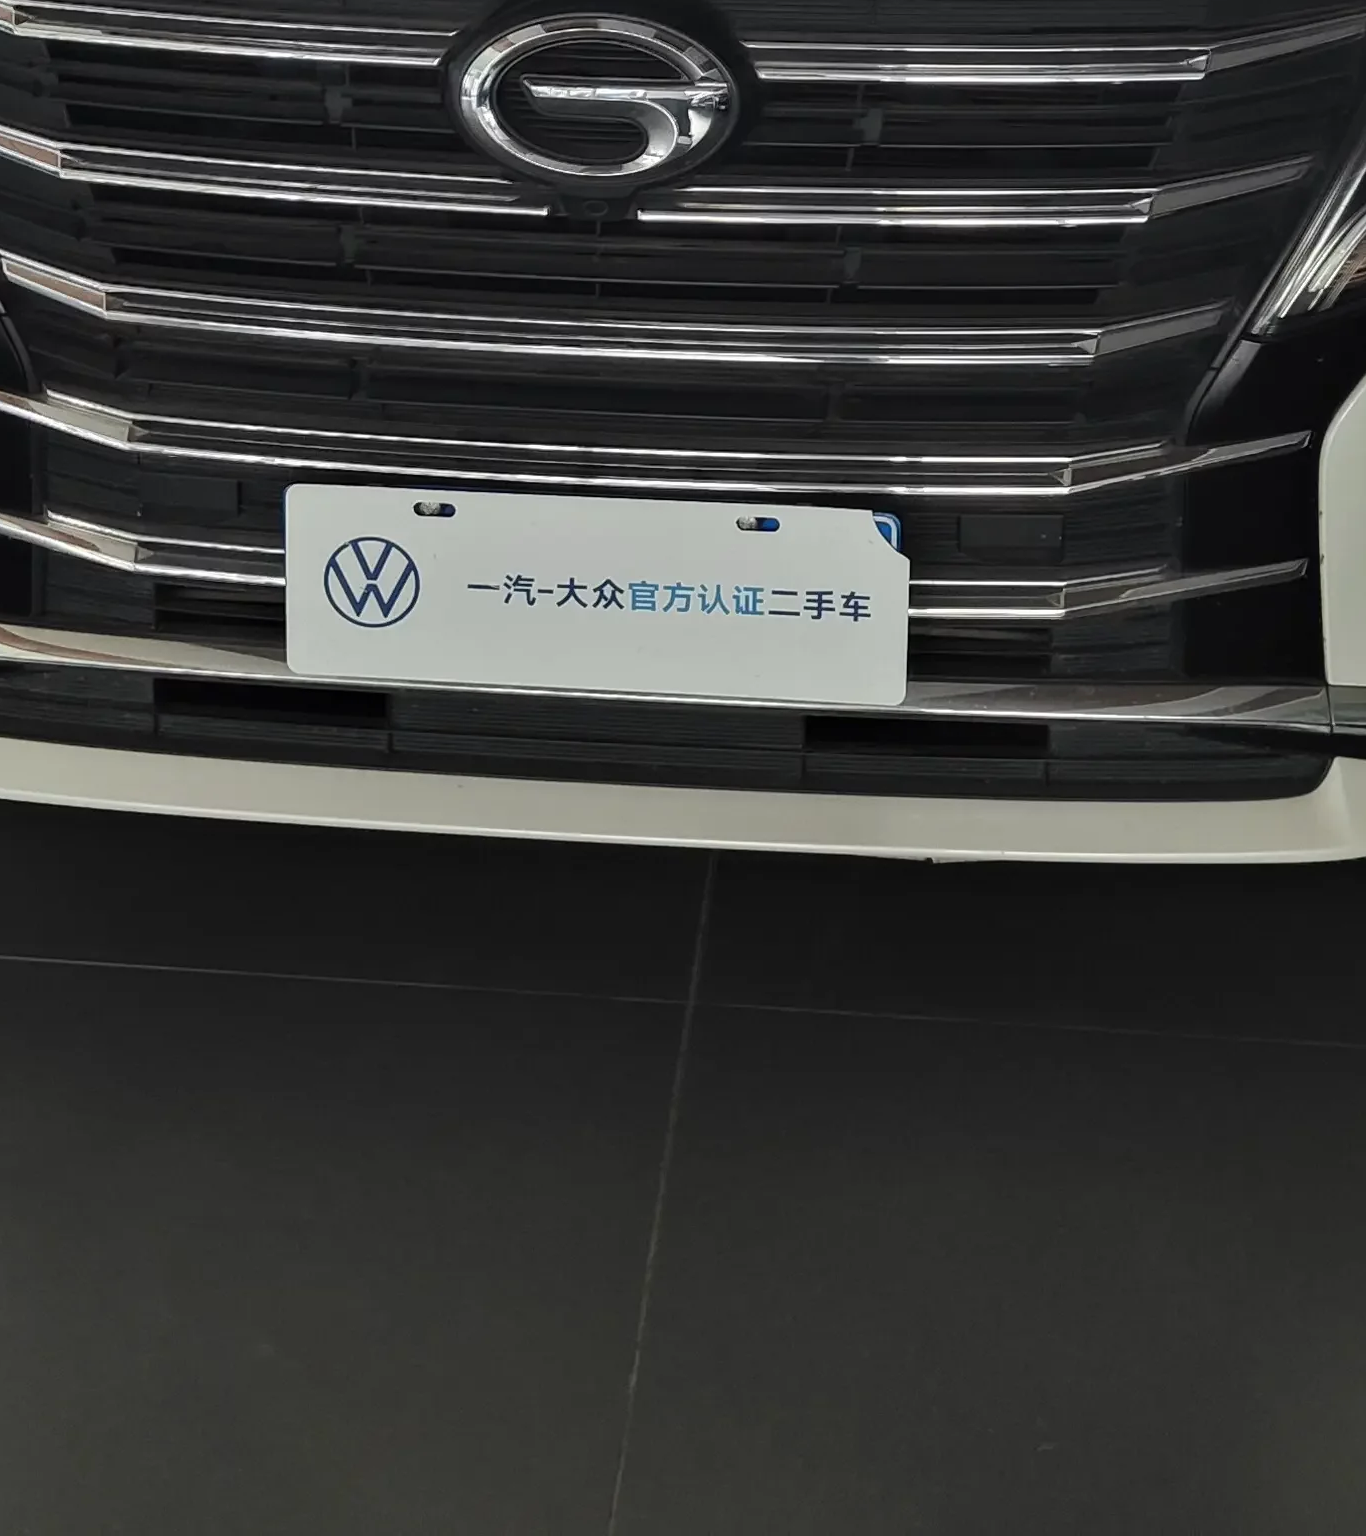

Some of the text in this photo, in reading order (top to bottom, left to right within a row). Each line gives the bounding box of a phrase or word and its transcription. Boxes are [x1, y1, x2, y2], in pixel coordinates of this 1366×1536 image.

[467, 574, 872, 622] 一汽-大众官方认证二手车
